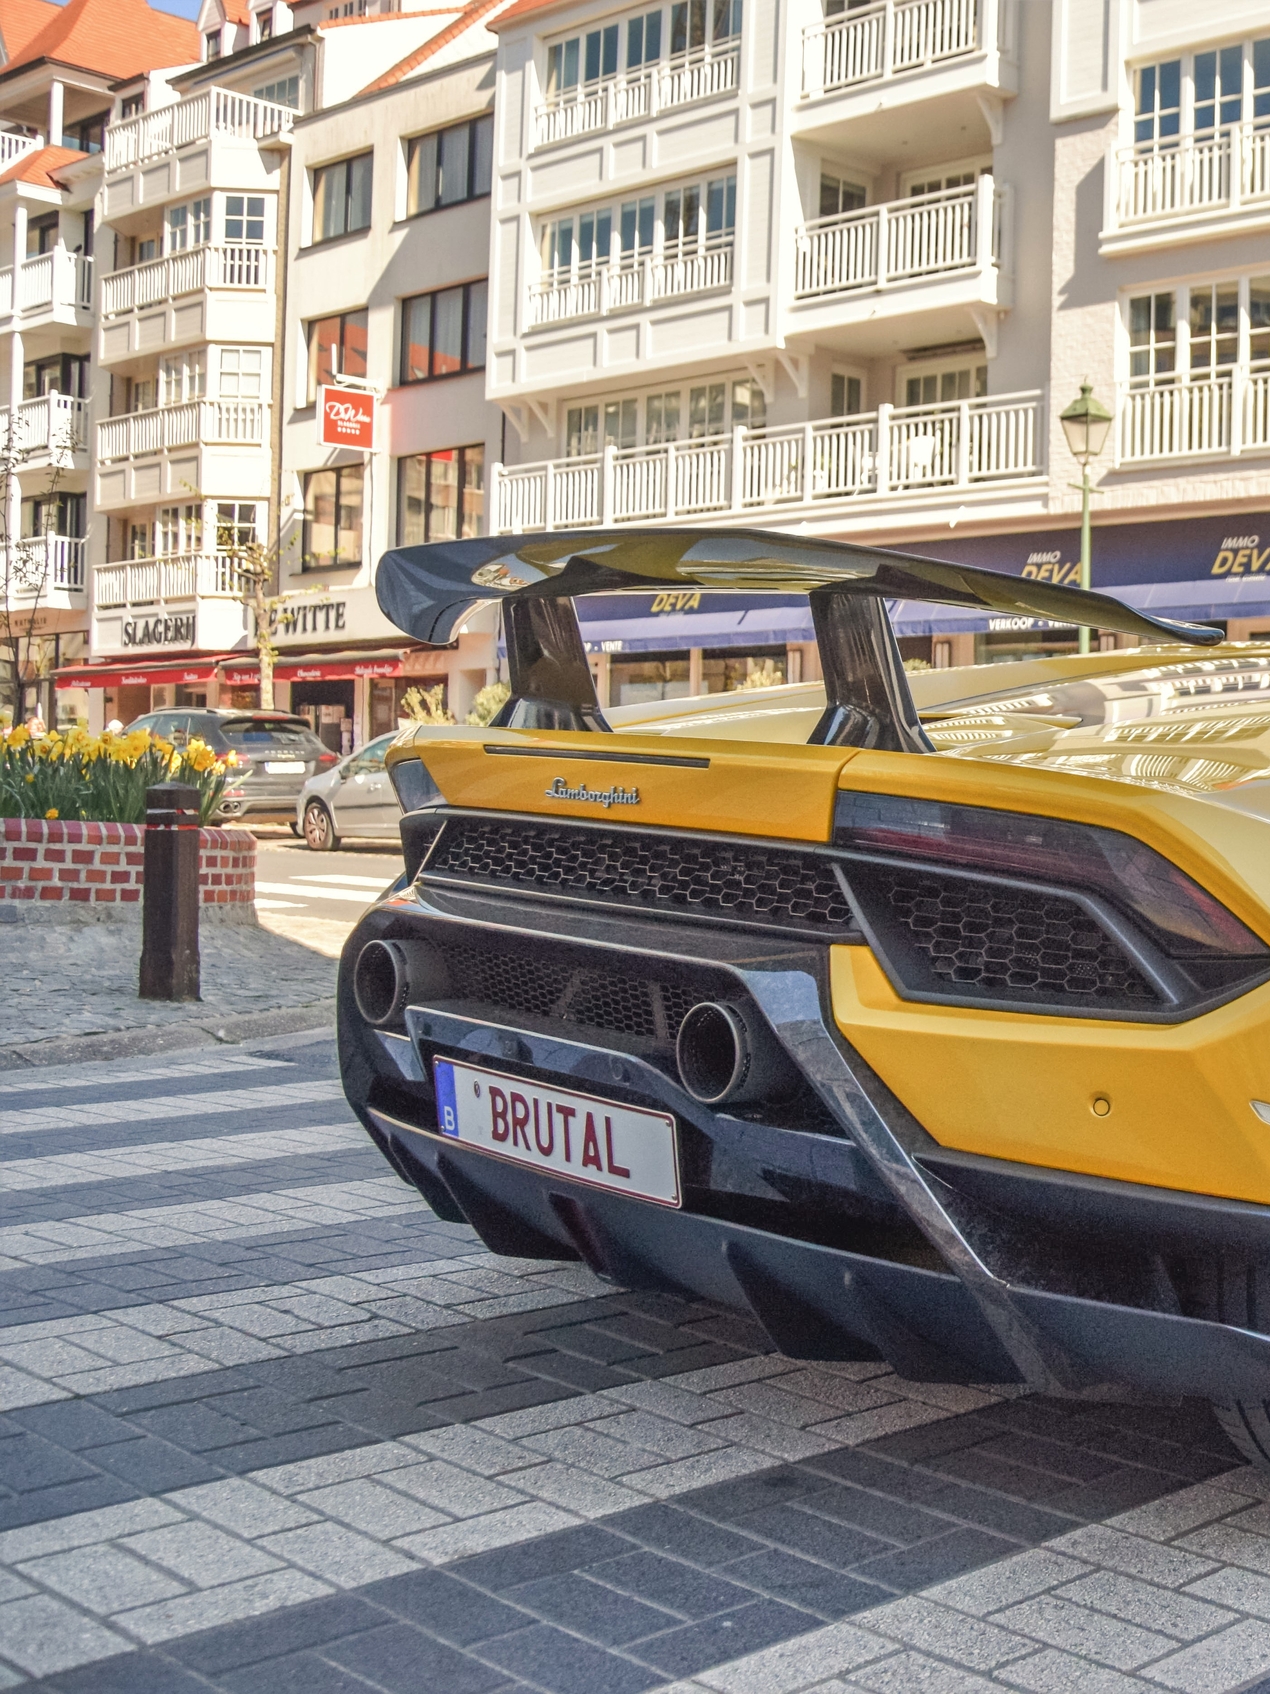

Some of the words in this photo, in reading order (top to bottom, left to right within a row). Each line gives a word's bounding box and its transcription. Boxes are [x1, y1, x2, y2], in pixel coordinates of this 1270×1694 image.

[1221, 535, 1259, 549] IMMO
[1026, 551, 1061, 564] IMMO
[650, 593, 701, 612] DEVA
[124, 614, 197, 649] SLAGERIJ
[283, 602, 346, 634] WITTE
[989, 617, 1034, 631] VERKOOP
[601, 641, 623, 653] VENTE
[545, 777, 640, 808] Lamborghini
[444, 1106, 455, 1131] B
[488, 1085, 631, 1179] BRUTAL
